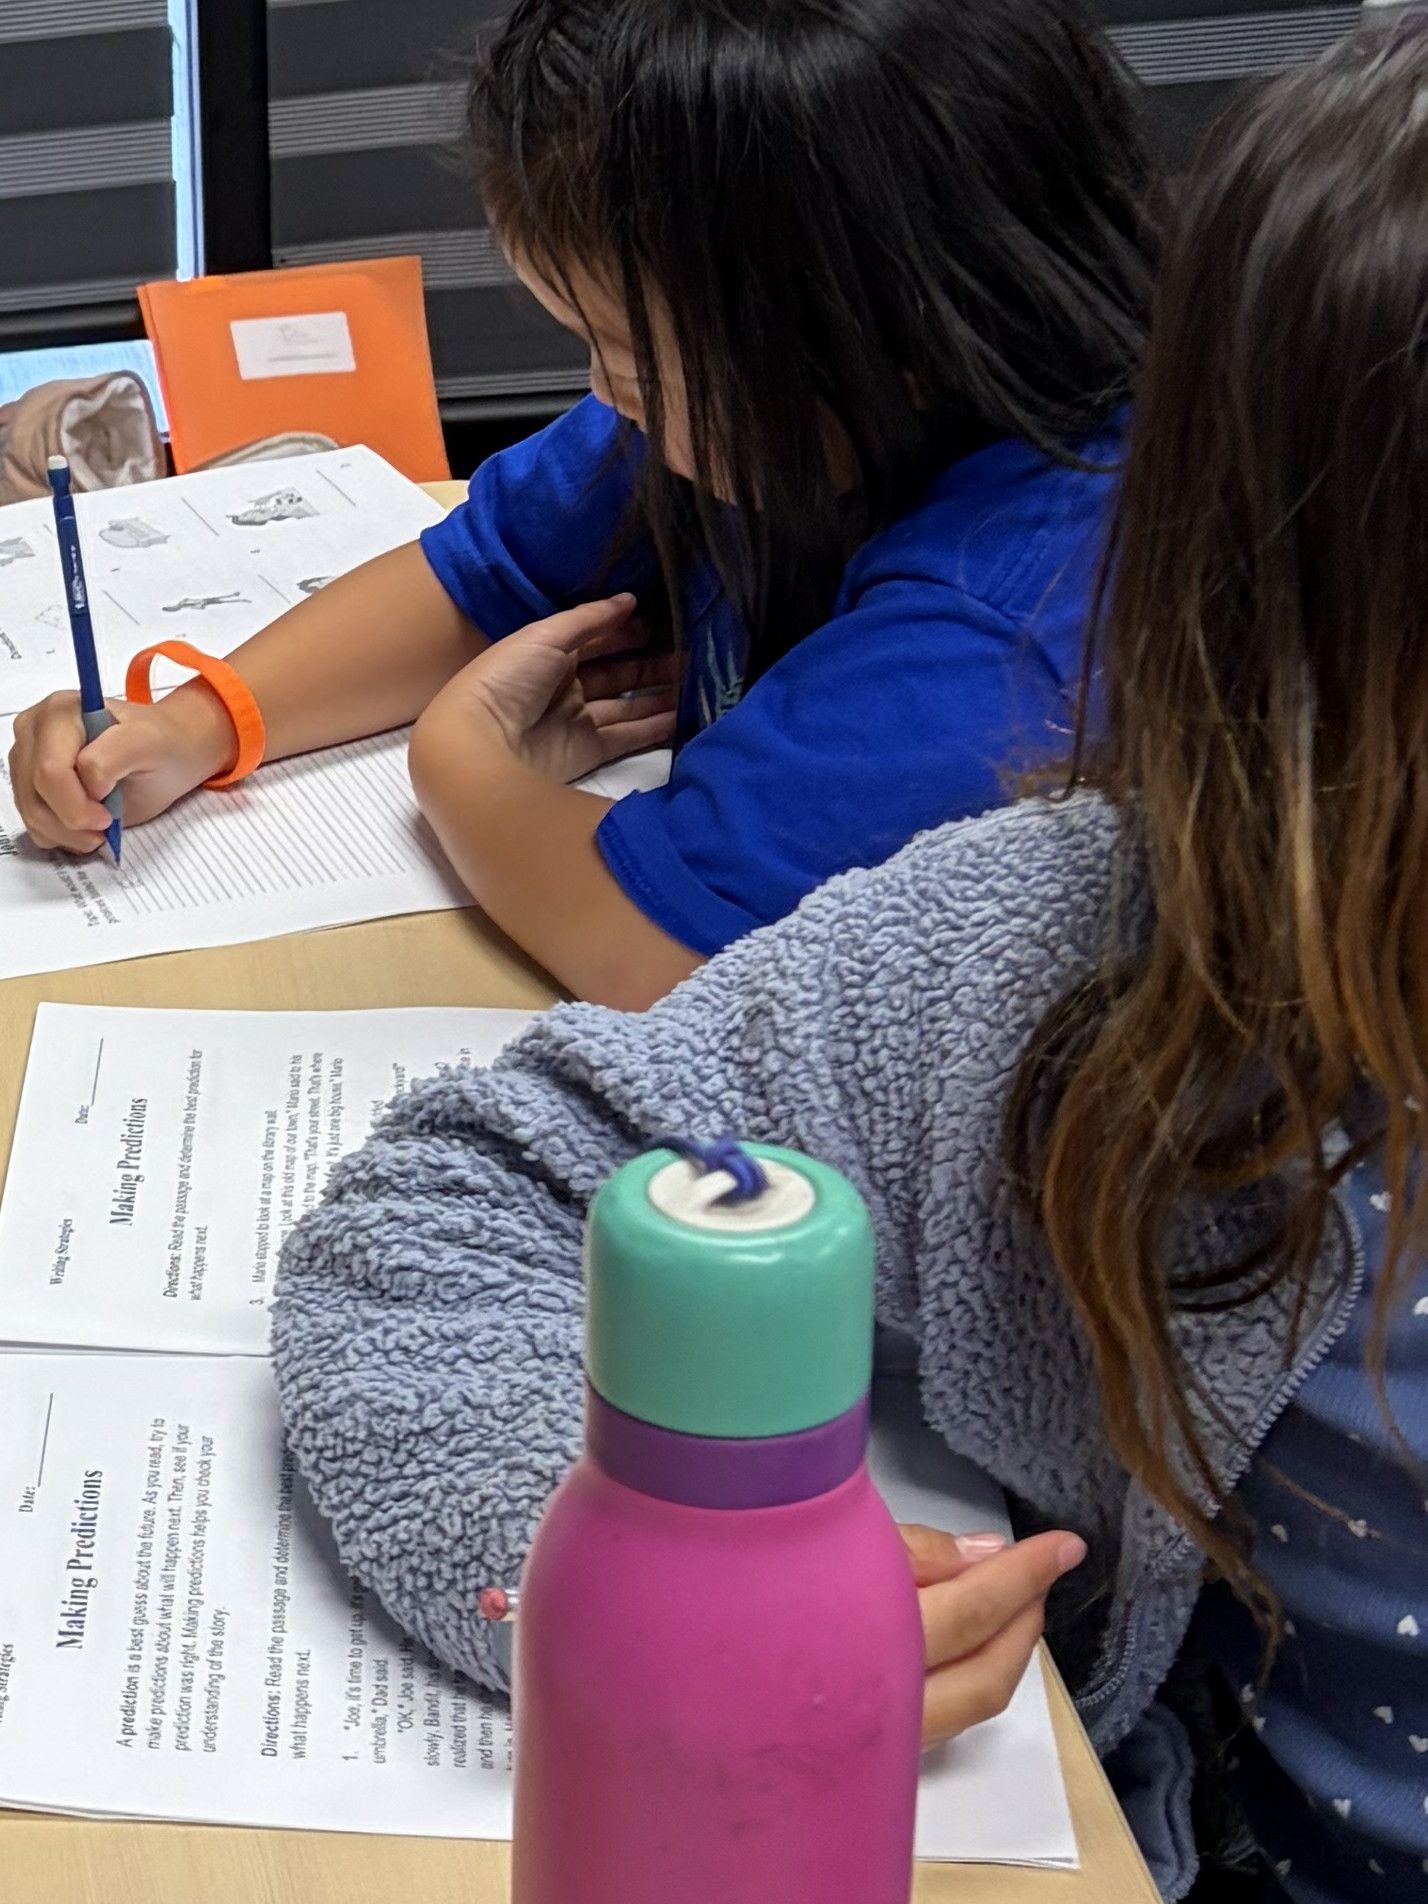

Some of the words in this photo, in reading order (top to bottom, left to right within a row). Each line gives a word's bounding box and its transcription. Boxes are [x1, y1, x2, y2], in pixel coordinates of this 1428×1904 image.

[115, 1097, 148, 1170] Predictions
[108, 1173, 145, 1226] Making
[149, 1429, 168, 1442] try
[146, 1443, 164, 1468] read,
[146, 1469, 162, 1488] you
[17, 1485, 36, 1512] Date:
[65, 1469, 103, 1570] Predictions
[136, 1506, 156, 1539] future.
[135, 1541, 153, 1558] the
[133, 1559, 151, 1591] about
[55, 1577, 98, 1649] Making
[131, 1592, 149, 1625] guess
[208, 1606, 230, 1637] story.
[126, 1627, 144, 1651] best
[206, 1639, 224, 1657] the
[294, 1648, 311, 1676] next.
[118, 1675, 139, 1736] prediction
[200, 1672, 226, 1753] understanding
[289, 1678, 313, 1729] happens
[288, 1729, 307, 1759] what
